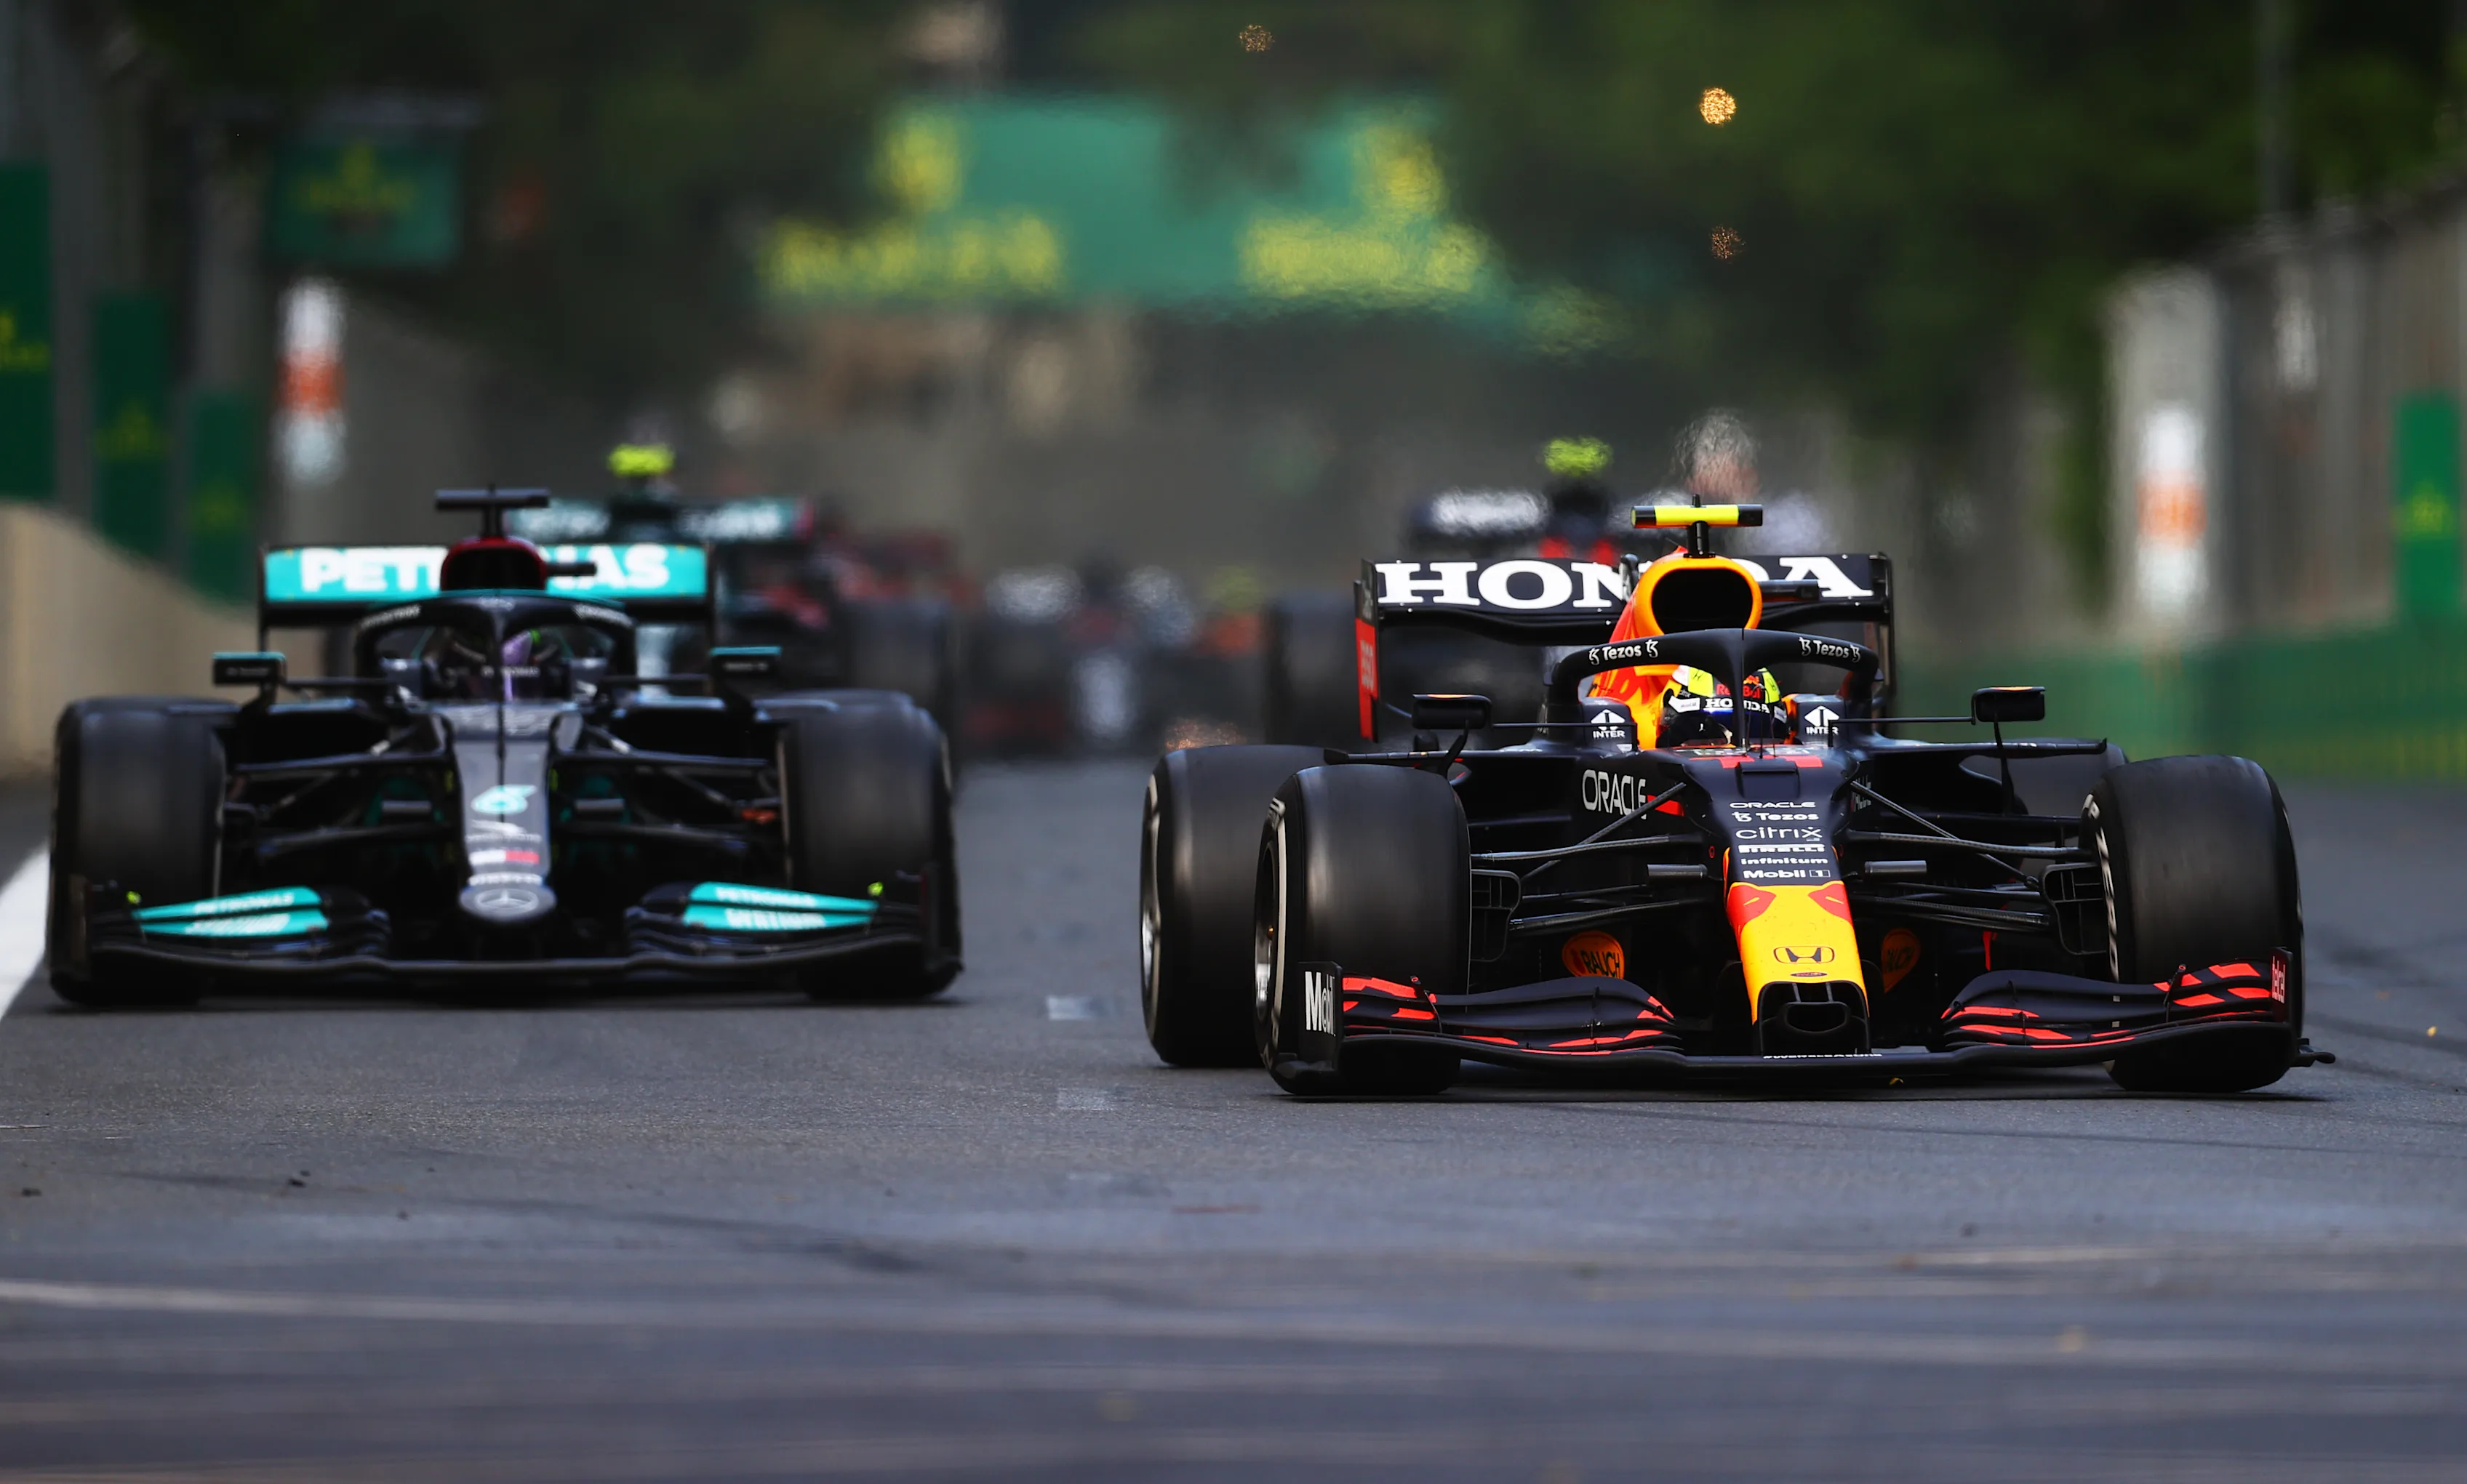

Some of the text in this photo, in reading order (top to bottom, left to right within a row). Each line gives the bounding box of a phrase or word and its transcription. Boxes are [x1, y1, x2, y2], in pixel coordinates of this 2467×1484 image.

[300, 545, 670, 592] PETAS
[1375, 556, 1874, 610] HONA
[1602, 645, 1642, 661] Tezos
[1812, 639, 1850, 659] Tezos
[1592, 730, 1626, 739] INTER
[1806, 726, 1839, 736] INTER
[1582, 769, 1647, 820] ORACLE
[1755, 812, 1820, 821] Tezos
[1735, 826, 1823, 839] citrix
[1738, 843, 1826, 854] PIRELLI
[1743, 870, 1807, 878] Mobil
[1580, 950, 1621, 979] RAUCH
